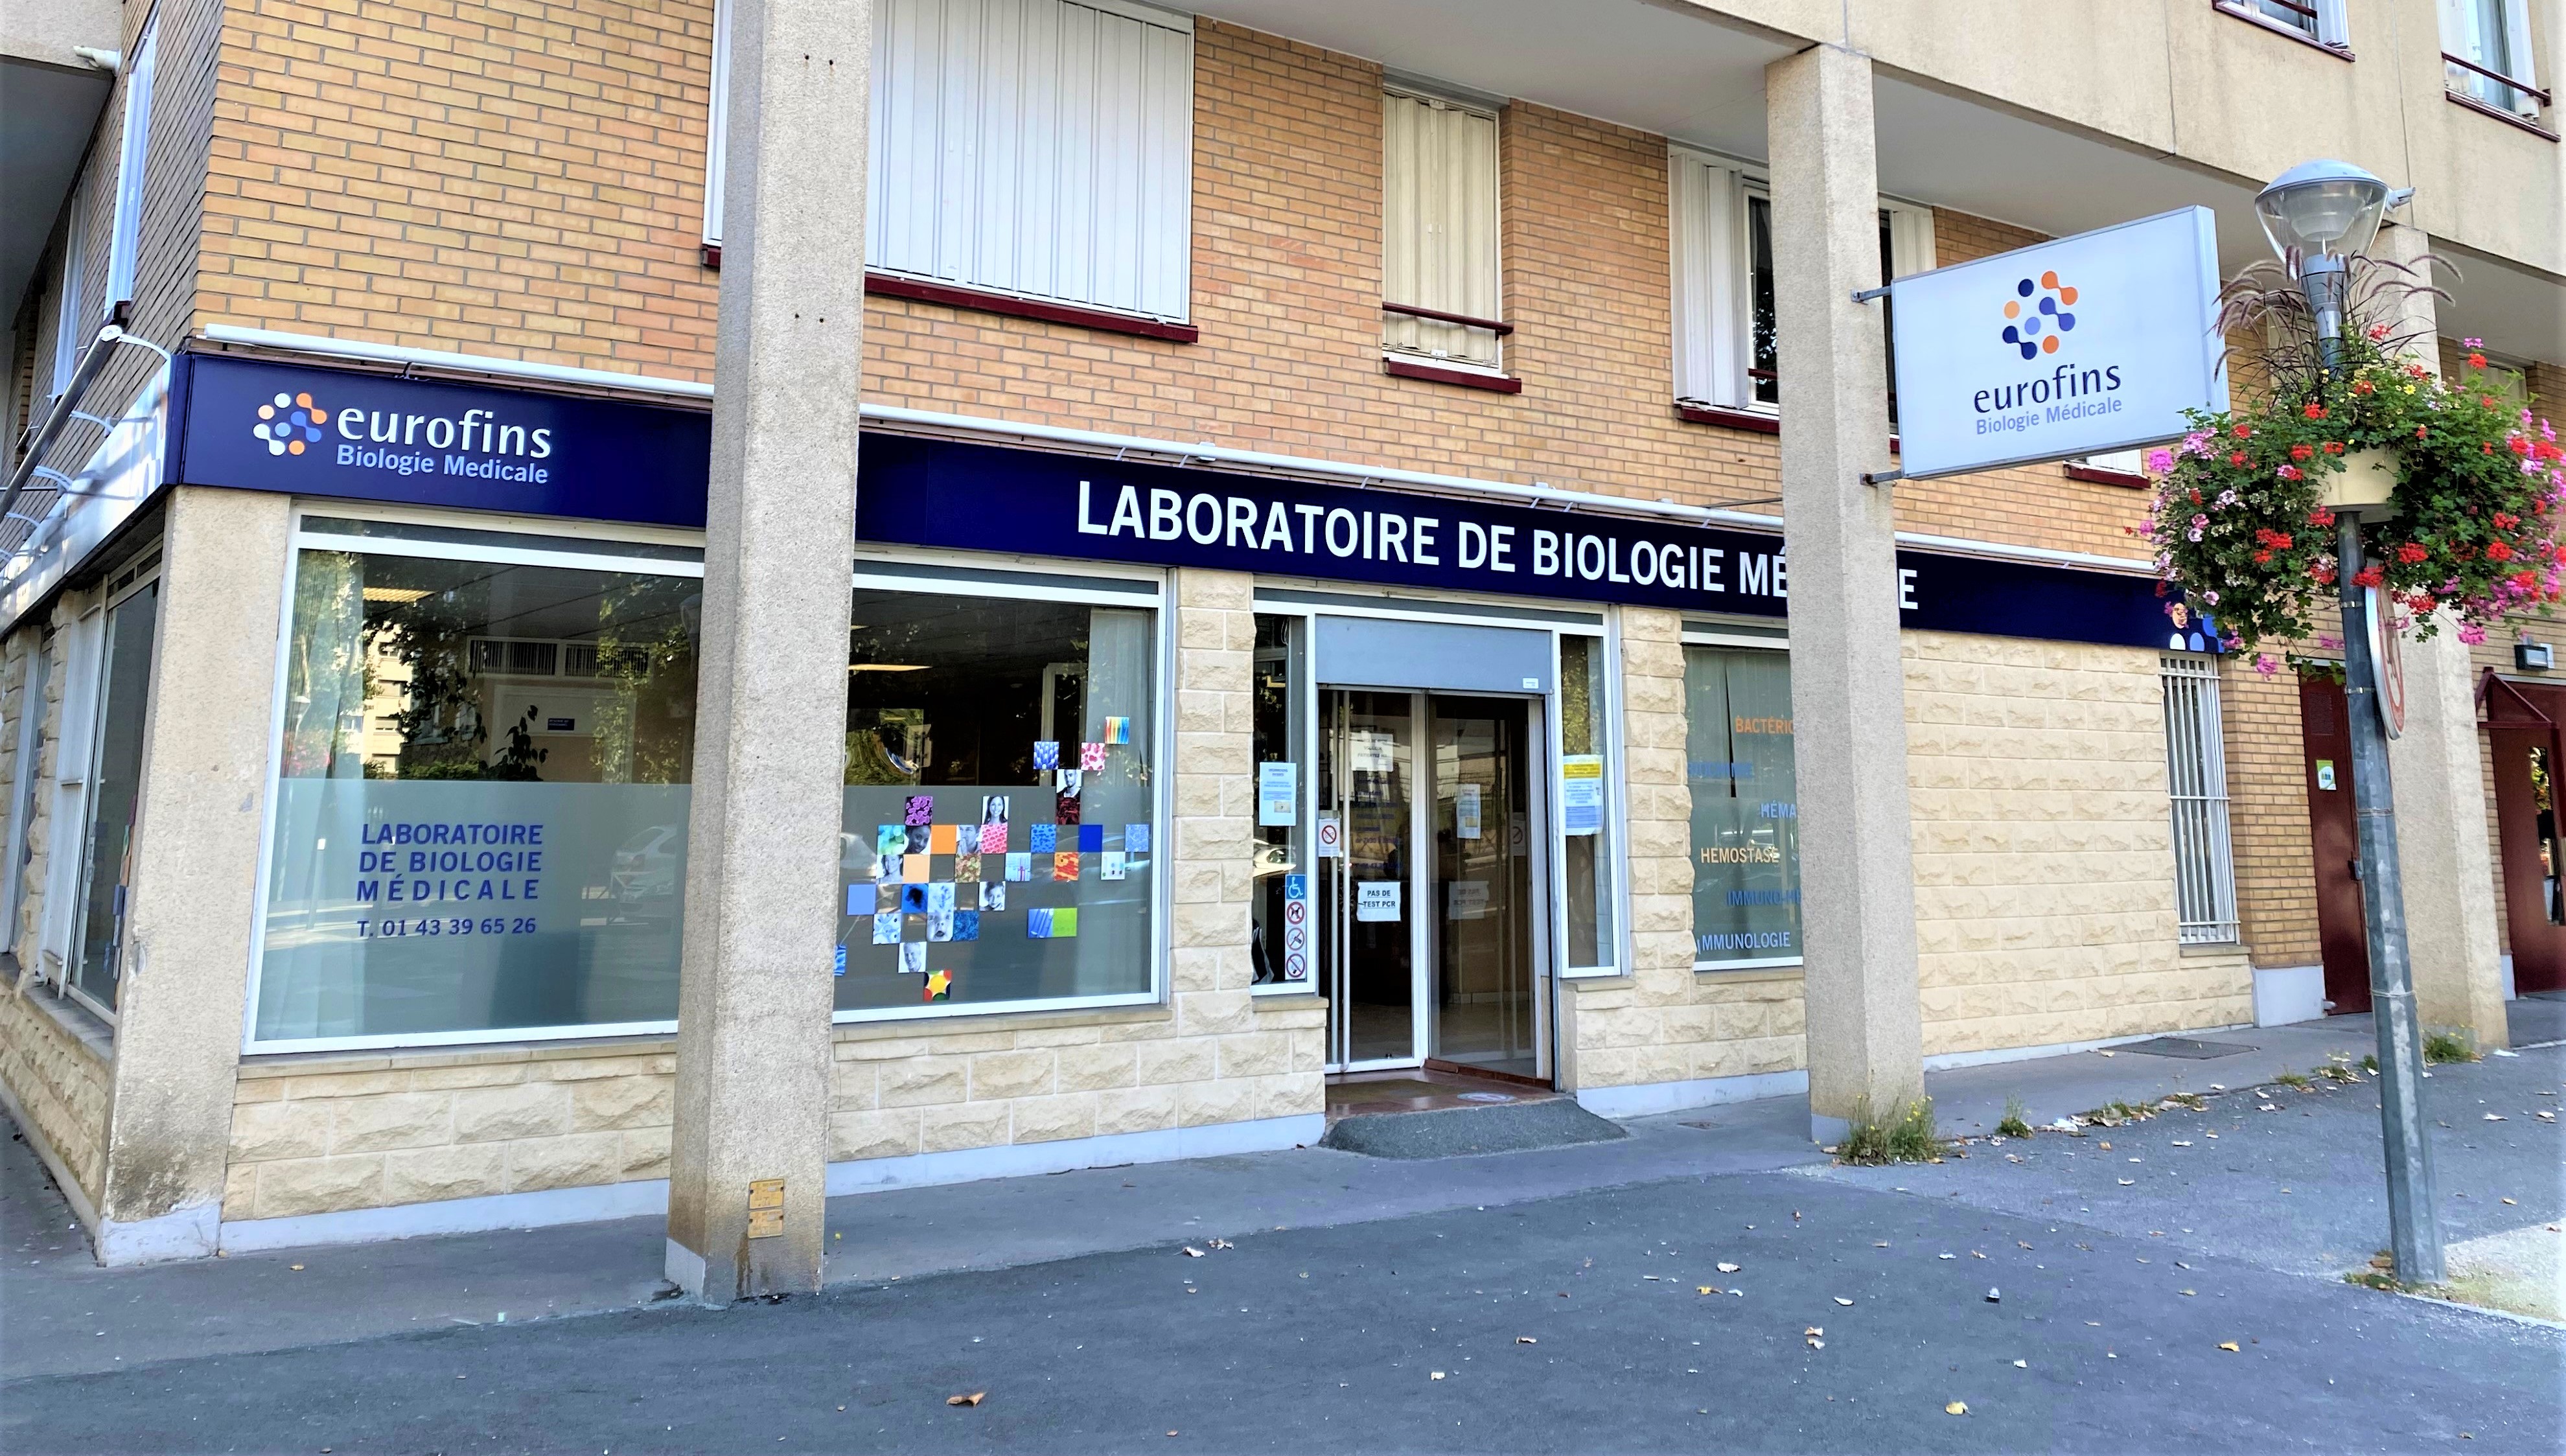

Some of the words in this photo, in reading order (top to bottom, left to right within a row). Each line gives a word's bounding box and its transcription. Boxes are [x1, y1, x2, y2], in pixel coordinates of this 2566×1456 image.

[1974, 363, 2121, 413] eurofins
[1976, 411, 2040, 435] Biologie
[2046, 398, 2123, 423] Médicale
[337, 407, 552, 459] eurofins
[336, 444, 435, 476] Biologie
[443, 455, 549, 484] Medicale
[1078, 480, 1440, 566] LABORATOIRE
[1459, 521, 1516, 573] DE
[1533, 529, 1725, 592] BIOLOGIE
[1761, 800, 1797, 818] HÉMA
[361, 824, 544, 845] LABORATOIRE
[359, 851, 397, 873] DE
[409, 851, 542, 873] BIOLOGIE
[1700, 848, 1779, 863] HEMOSTASE
[356, 873, 539, 901] MÉDICALE
[357, 920, 374, 937] T.
[382, 919, 406, 936] 01
[415, 919, 441, 936] 43
[448, 919, 473, 935] 39
[480, 918, 505, 934] 65
[512, 918, 537, 934] 26
[1696, 931, 1791, 954] IMMUNOLOGIE
